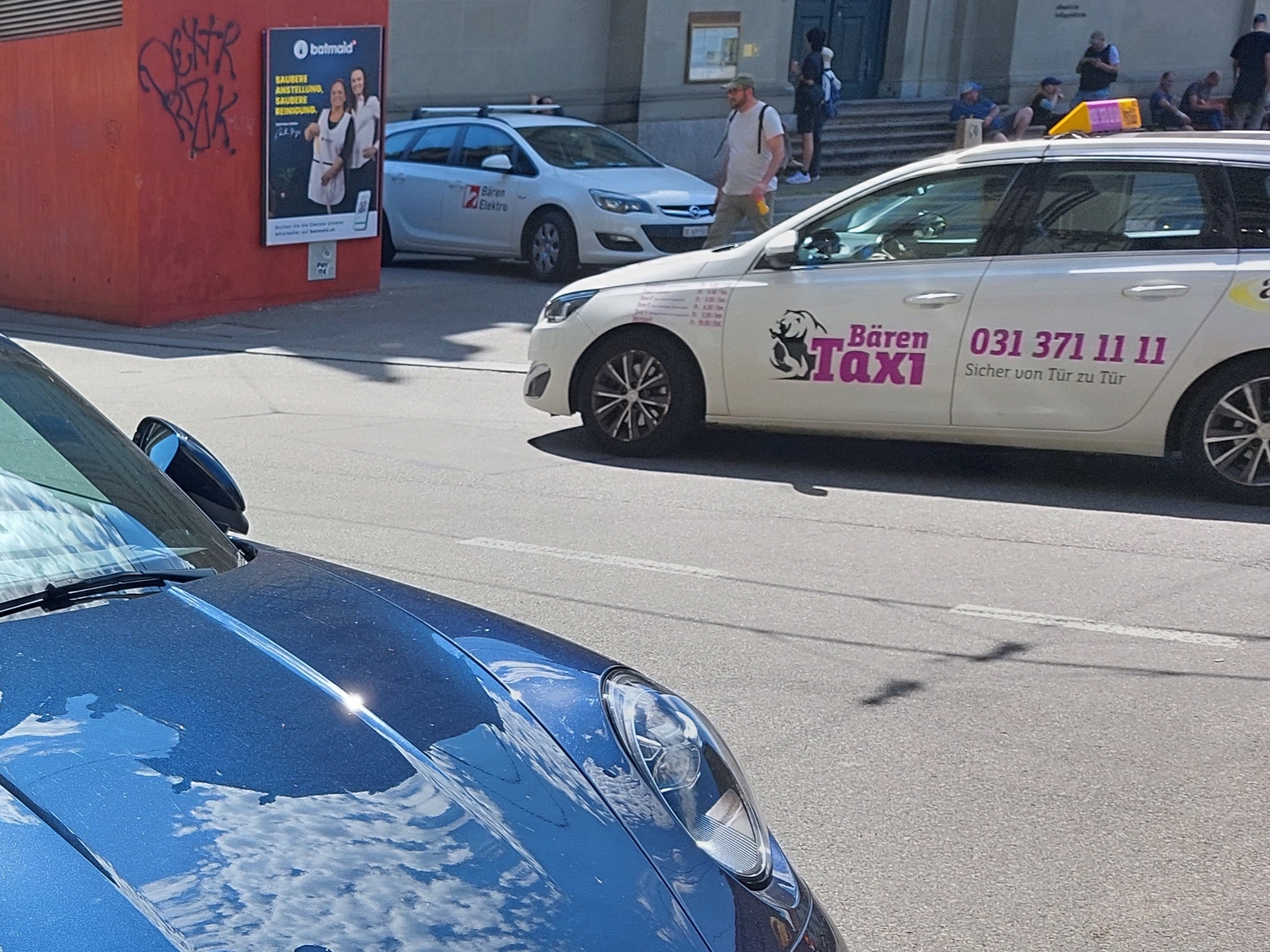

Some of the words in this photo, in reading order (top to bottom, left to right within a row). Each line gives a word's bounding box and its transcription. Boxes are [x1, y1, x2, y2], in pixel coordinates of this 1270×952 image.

[310, 41, 353, 55] batmaid
[275, 74, 308, 84] SAUBERE
[275, 95, 308, 105] SAUBERE
[481, 185, 506, 197] Bären
[480, 199, 508, 212] Elektro
[847, 324, 929, 349] Bären
[970, 328, 1023, 357] 031
[1032, 331, 1085, 360] 371
[1093, 334, 1126, 363] 11
[1134, 336, 1167, 365] 11
[811, 337, 927, 386] Taxi
[965, 363, 1011, 378] Sicher
[1014, 368, 1043, 381] von
[1048, 367, 1073, 382] Tür
[1076, 372, 1095, 384] zu
[1100, 370, 1126, 386] Tür
